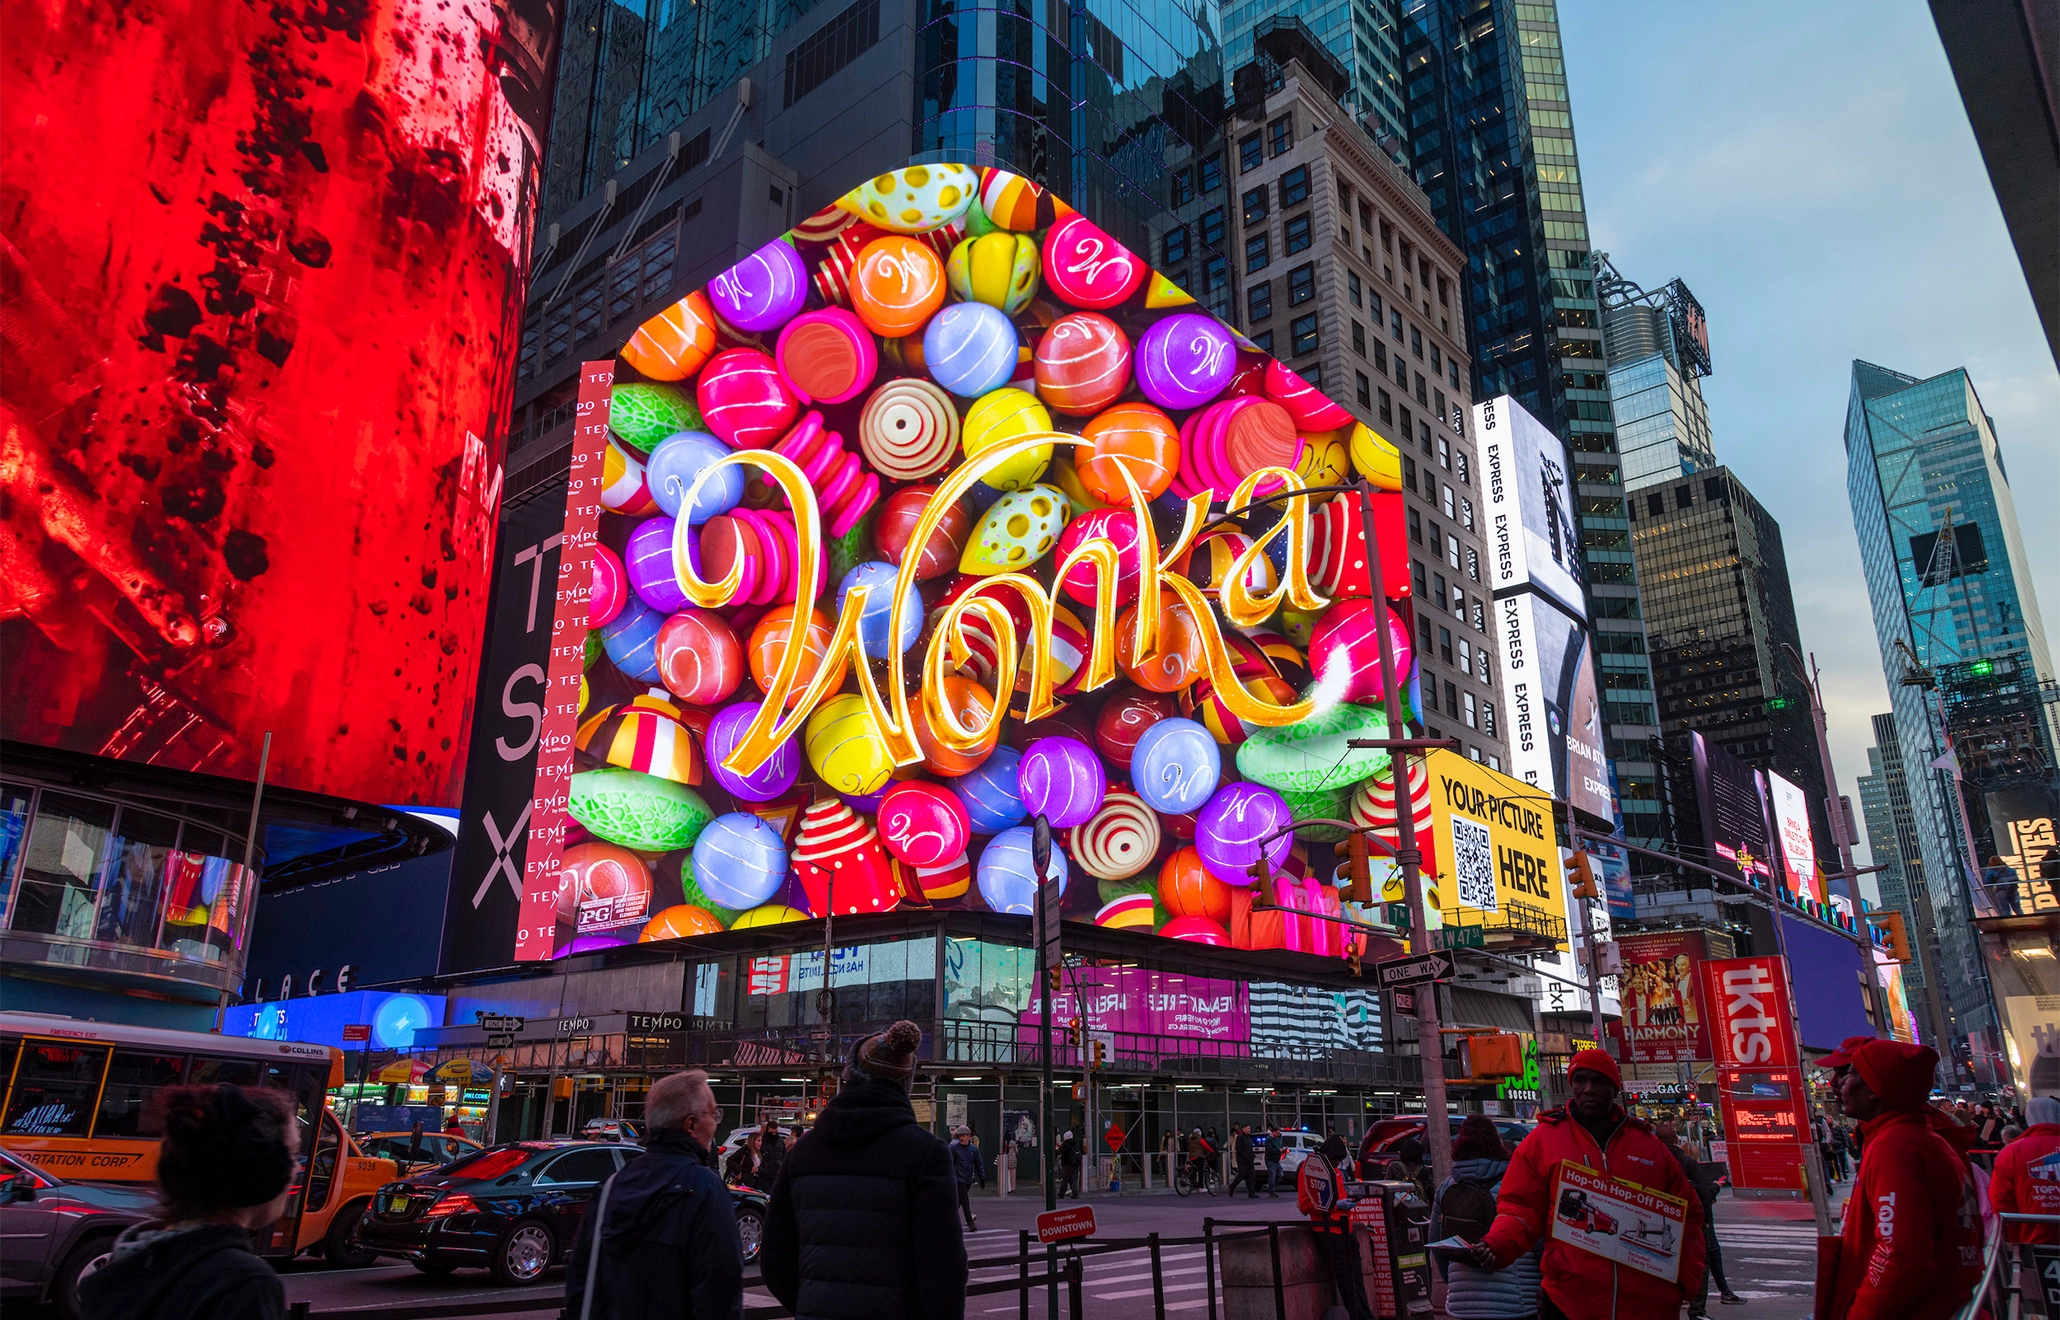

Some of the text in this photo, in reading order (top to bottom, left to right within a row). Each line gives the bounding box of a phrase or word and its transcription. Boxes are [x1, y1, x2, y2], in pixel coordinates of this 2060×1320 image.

[1487, 443, 1504, 504] EXPRESS
[1494, 514, 1513, 581] EXPRESS
[672, 431, 1350, 777] Wonka
[1504, 598, 1524, 670] EXPRESS
[1514, 682, 1534, 753] EXPRESS
[1440, 774, 1544, 840] YOUR PICTURE
[1498, 844, 1550, 900] HERE
[580, 908, 610, 925] PG
[1446, 928, 1480, 946] W 47 St
[1389, 960, 1441, 980] ONE WAY
[1398, 994, 1410, 1007] ONE
[632, 1011, 682, 1034] TEMPO
[1722, 964, 1776, 1064] tkts
[50, 1028, 84, 1038] EMERGENCY
[488, 1020, 500, 1028] ONE
[1623, 1025, 1700, 1041] HARMONY
[292, 1046, 324, 1056] COLLINS
[1508, 1090, 1536, 1100] SOCCER
[91, 1156, 132, 1168] CORP.
[358, 1162, 376, 1172] 9038
[1310, 1178, 1326, 1192] STOP
[1610, 1184, 1654, 1208] Hop-Off
[1656, 1199, 1682, 1218] Pass
[1042, 1220, 1093, 1236] DOWNTOWN
